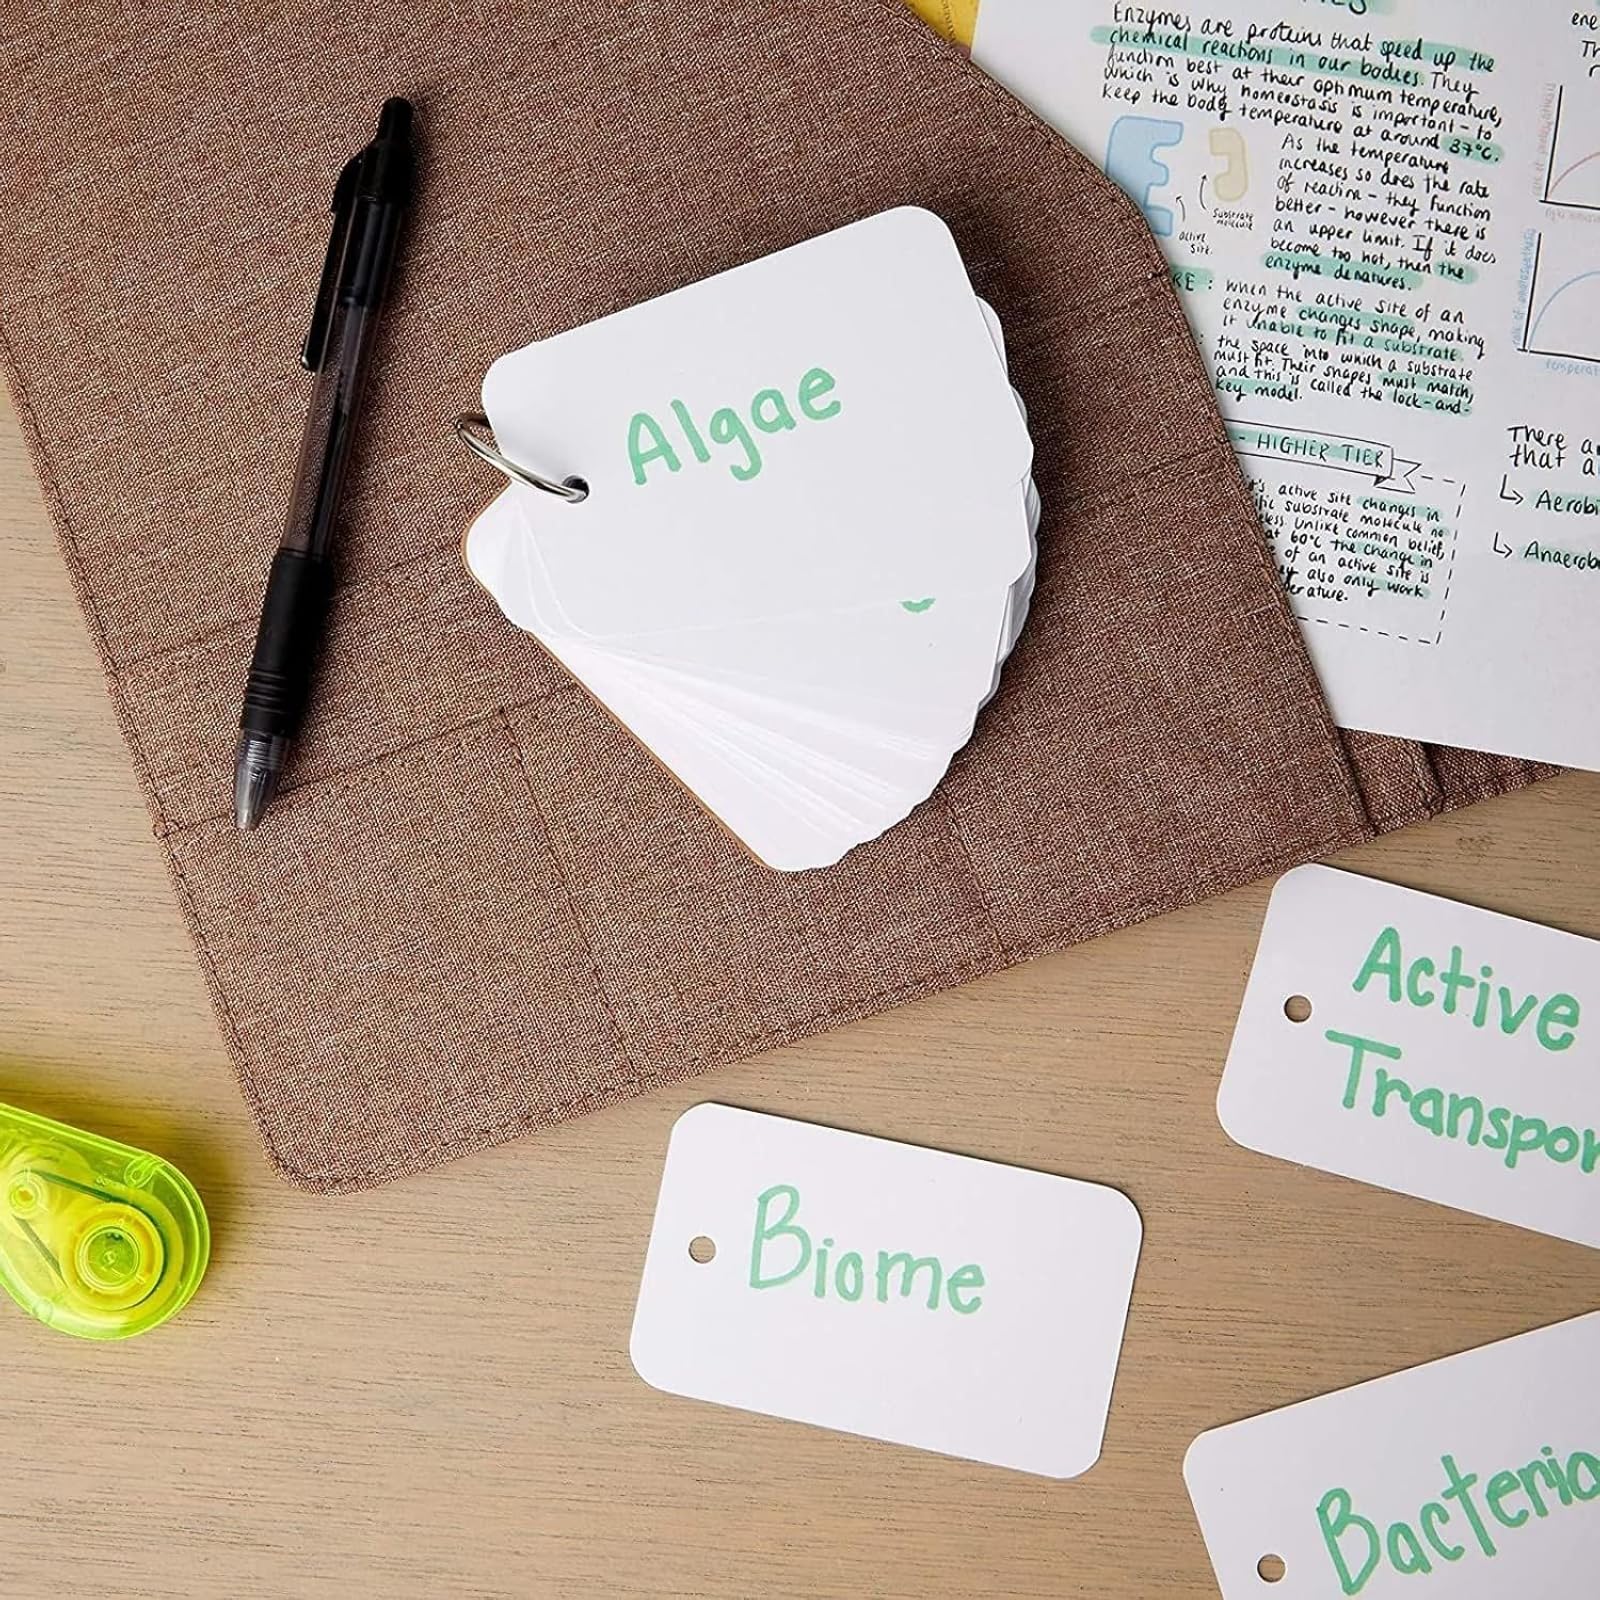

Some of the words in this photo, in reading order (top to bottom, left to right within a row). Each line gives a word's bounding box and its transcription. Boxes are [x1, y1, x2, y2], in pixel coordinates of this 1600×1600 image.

[1113, 1, 1191, 33] Enzymes
[1200, 18, 1234, 37] are
[1246, 21, 1322, 45] proteins
[1331, 32, 1373, 51] that
[1380, 38, 1423, 62] speed
[1434, 51, 1456, 71] up
[1469, 52, 1495, 72] the
[1108, 43, 1174, 70] function
[1186, 58, 1223, 74] best
[1231, 66, 1252, 80] at
[1260, 68, 1304, 87] their
[1313, 79, 1392, 104] optimum
[1400, 89, 1502, 128] temperature,
[1109, 26, 1188, 51] chemical
[1202, 40, 1272, 65] reactions
[1290, 48, 1305, 68] in
[1318, 56, 1352, 70] our
[1360, 56, 1424, 87] bodies.
[1431, 72, 1480, 103] They
[1104, 66, 1152, 82] which
[1166, 71, 1179, 87] is
[1191, 78, 1227, 97] why
[1351, 100, 1362, 118] is
[1373, 104, 1454, 133] important
[1477, 124, 1492, 140] to
[1152, 89, 1179, 106] the
[1187, 94, 1232, 121] body
[1239, 103, 1342, 133] temperature
[1353, 125, 1372, 137] at
[1380, 128, 1440, 149] around
[1281, 133, 1303, 150] As
[1317, 137, 1340, 154] the
[1351, 141, 1449, 174] temperature
[1277, 172, 1295, 193] of
[1305, 181, 1362, 200] reaction
[1386, 191, 1420, 217] they
[1430, 194, 1490, 221] function
[1279, 158, 1348, 181] increases
[1356, 168, 1371, 182] so
[1381, 168, 1415, 189] does
[1423, 173, 1450, 194] the
[1459, 179, 1490, 198] rate
[1275, 195, 1322, 214] better
[1344, 206, 1416, 229] however
[1424, 219, 1469, 240] there
[1475, 223, 1486, 240] is
[1271, 237, 1321, 256] become
[1332, 246, 1351, 262] too
[1362, 251, 1391, 270] hot,
[1398, 256, 1431, 273] then
[1439, 262, 1465, 280] the
[1273, 218, 1294, 233] an
[1309, 223, 1353, 240] upper
[1412, 234, 1433, 261] If
[1445, 240, 1456, 256] it
[1465, 245, 1496, 263] does
[1265, 255, 1322, 280] enzyme
[1334, 264, 1412, 291] denatures.
[1277, 285, 1302, 302] the
[1315, 293, 1362, 311] active
[1415, 303, 1430, 322] of
[1440, 309, 1464, 324] an
[1223, 298, 1288, 325] enzyme
[1299, 309, 1360, 333] changes
[1428, 328, 1485, 360] making
[1223, 315, 1237, 327] it
[1246, 320, 1304, 338] unable
[1314, 327, 1327, 340] to
[1335, 328, 1354, 346] fit
[1363, 336, 1374, 349] a
[1214, 350, 1249, 363] must
[1281, 357, 1316, 372] Their
[1323, 366, 1371, 385] shapes
[1382, 376, 1416, 389] must
[1426, 381, 1474, 404] match,
[1217, 334, 1240, 349] the
[1251, 339, 1289, 356] space
[1340, 352, 1382, 370] which
[1388, 360, 1397, 373] a
[1407, 360, 1473, 381] substrate
[1215, 378, 1247, 402] key
[1254, 384, 1303, 402] model.
[1216, 365, 1250, 379] and
[1253, 368, 1281, 382] this
[1289, 372, 1300, 385] is
[1310, 378, 1351, 397] called
[1360, 386, 1383, 401] the
[627, 367, 842, 486] Algae
[1507, 425, 1567, 450] There
[1257, 433, 1330, 463] HIGHER
[1342, 443, 1385, 469] TIER
[1509, 444, 1566, 469] that
[1278, 484, 1318, 501] active
[1362, 497, 1416, 520] changes
[1426, 507, 1440, 522] in
[1285, 500, 1350, 523] substrate
[1360, 515, 1422, 534] molecule
[1431, 528, 1444, 538] no
[1330, 539, 1356, 553] the
[1363, 543, 1414, 568] change
[1420, 554, 1433, 568] in
[1346, 527, 1398, 548] common
[1284, 546, 1300, 563] of
[1308, 551, 1326, 564] an
[1338, 557, 1376, 573] active
[1420, 570, 1429, 584] is
[1307, 568, 1334, 583] also
[1343, 574, 1380, 597] only
[1387, 582, 1424, 597] work
[1352, 927, 1580, 1051] Active
[750, 1184, 985, 1314] Biome
[1316, 1446, 1600, 1596] Bacteria
